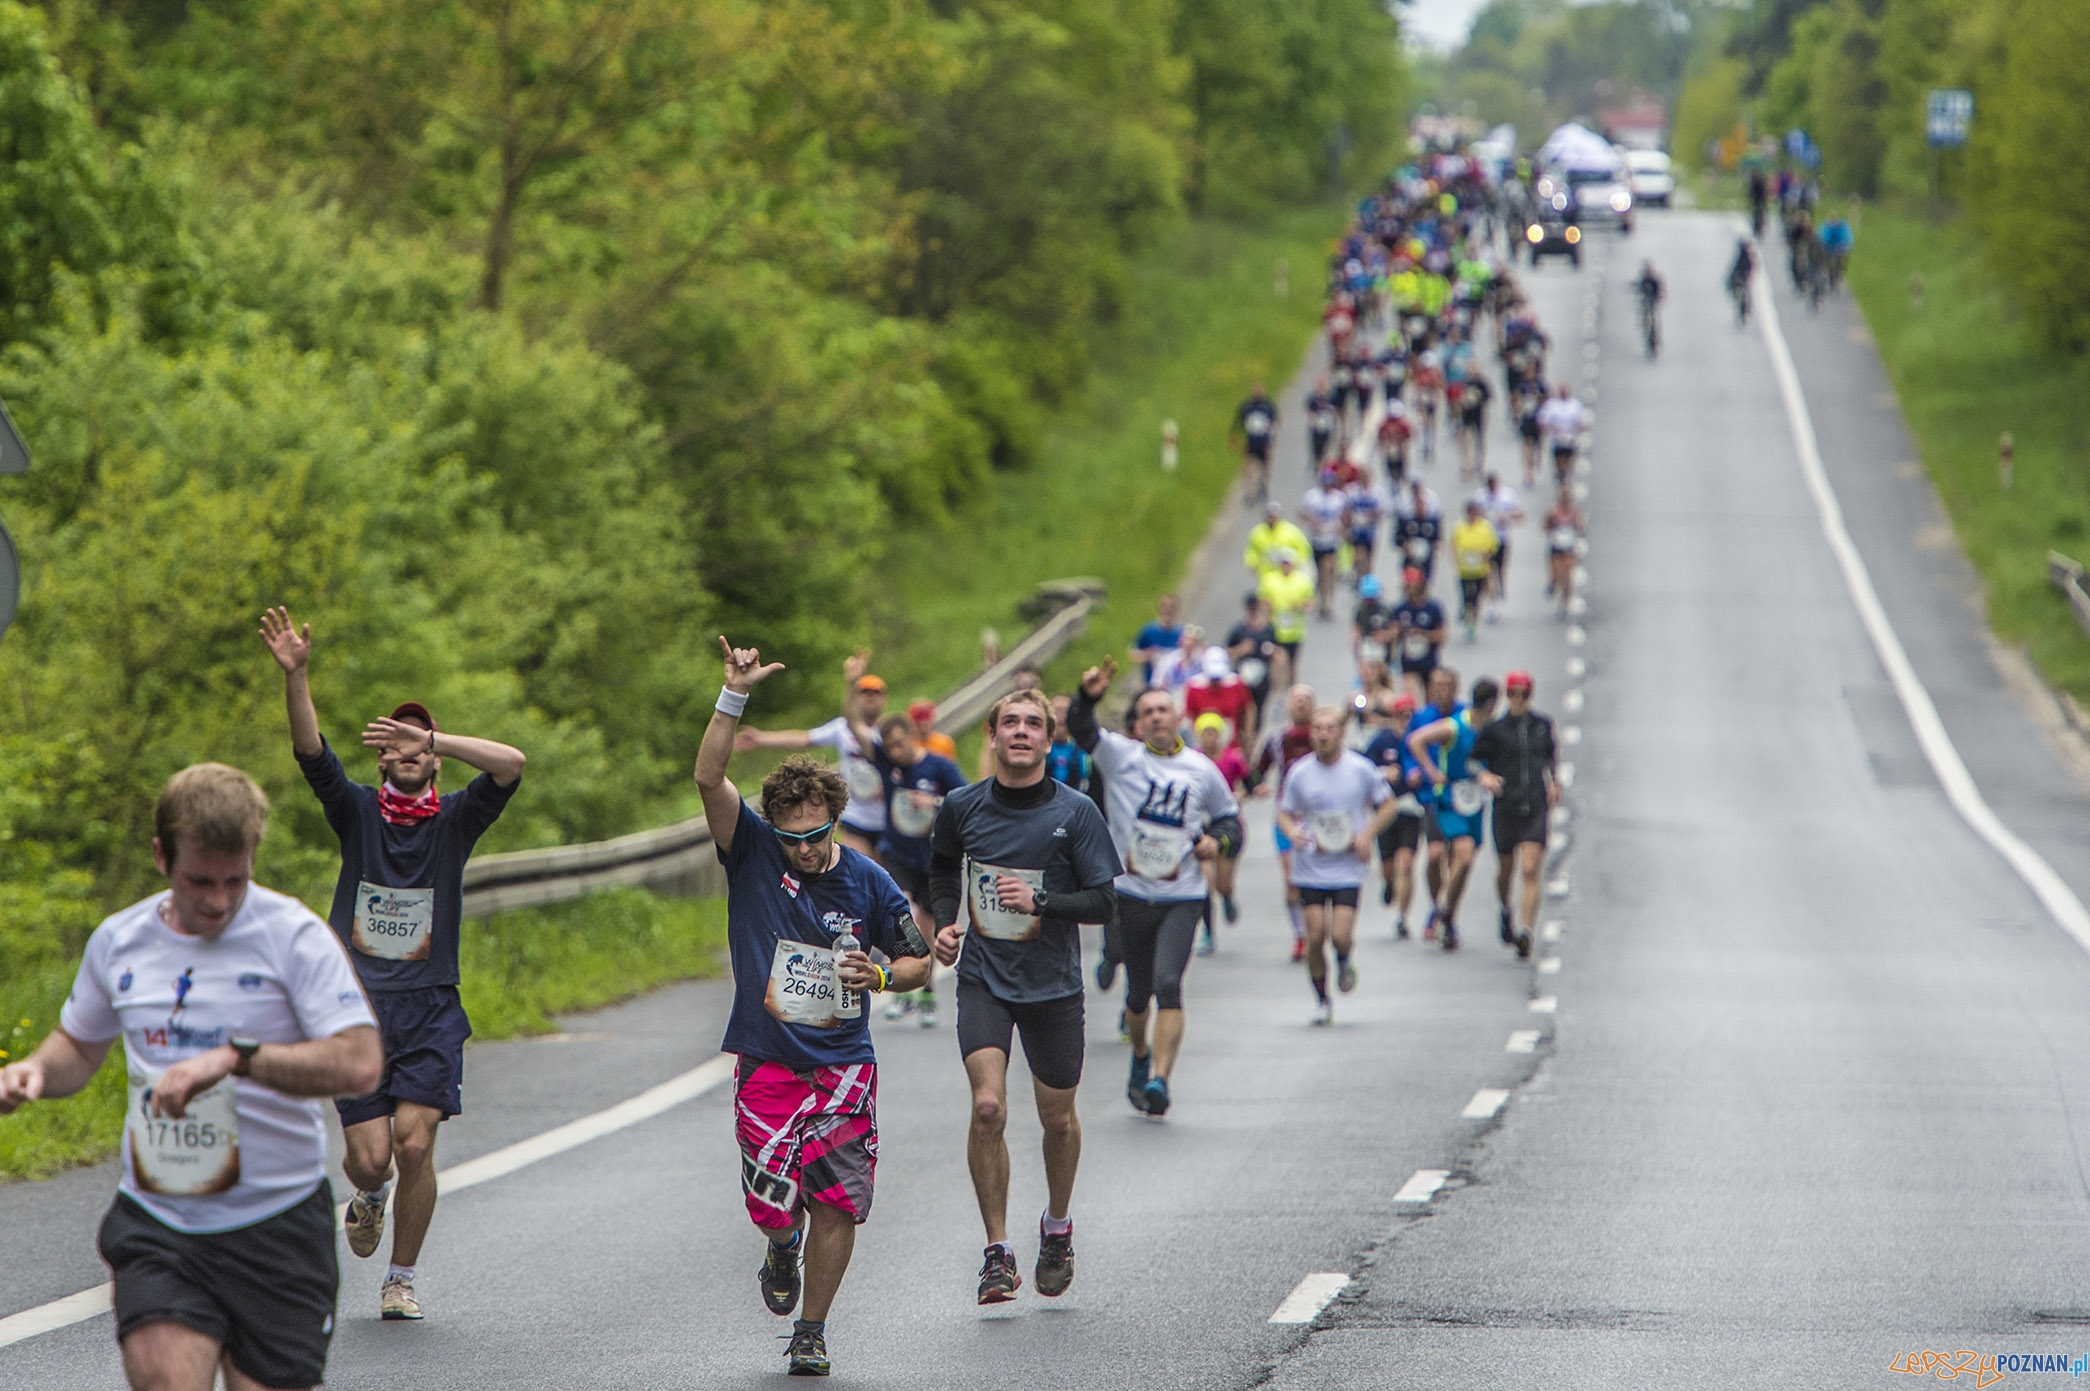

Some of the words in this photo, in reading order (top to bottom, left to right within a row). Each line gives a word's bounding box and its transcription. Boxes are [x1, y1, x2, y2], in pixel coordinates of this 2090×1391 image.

[367, 917, 418, 937] 36857
[783, 977, 835, 1001] 26494
[143, 1027, 169, 1049] 14
[146, 1121, 216, 1149] 17165
